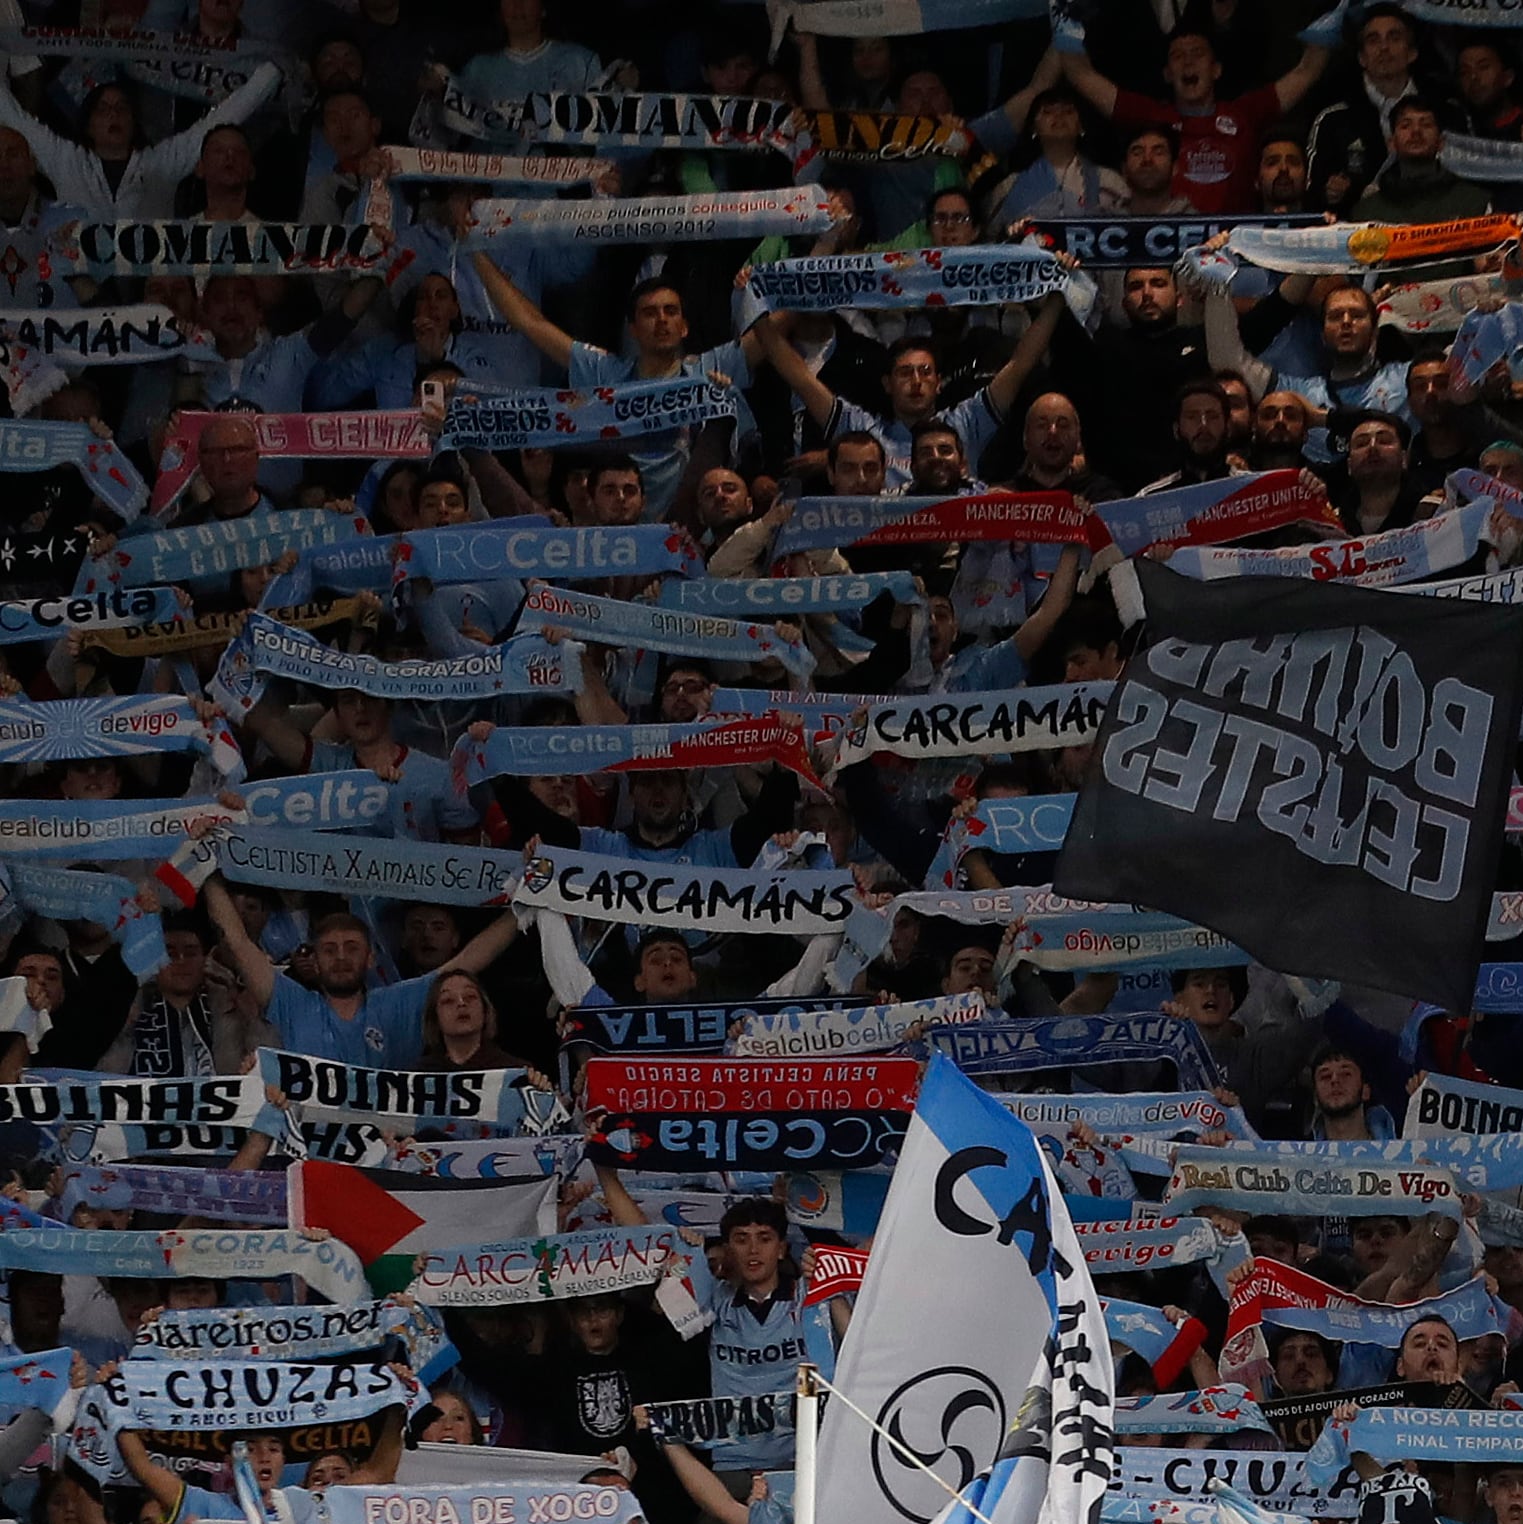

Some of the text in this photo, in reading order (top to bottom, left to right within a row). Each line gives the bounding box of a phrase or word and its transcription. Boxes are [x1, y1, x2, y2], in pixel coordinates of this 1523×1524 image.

[434, 526, 639, 571] RCCelta
[245, 779, 390, 827] Celta
[558, 866, 855, 923] CARCAMÄNS
[278, 1054, 484, 1118] BOINAS
[1184, 1164, 1233, 1192] Real
[1235, 1165, 1291, 1193] Club
[1359, 1172, 1393, 1197] De
[1399, 1173, 1451, 1204] Vigo
[134, 1302, 382, 1352] siareiros.net
[1392, 1411, 1464, 1430] NOSA
[1396, 1434, 1453, 1450] FINAL
[527, 1489, 621, 1524] XOGO
